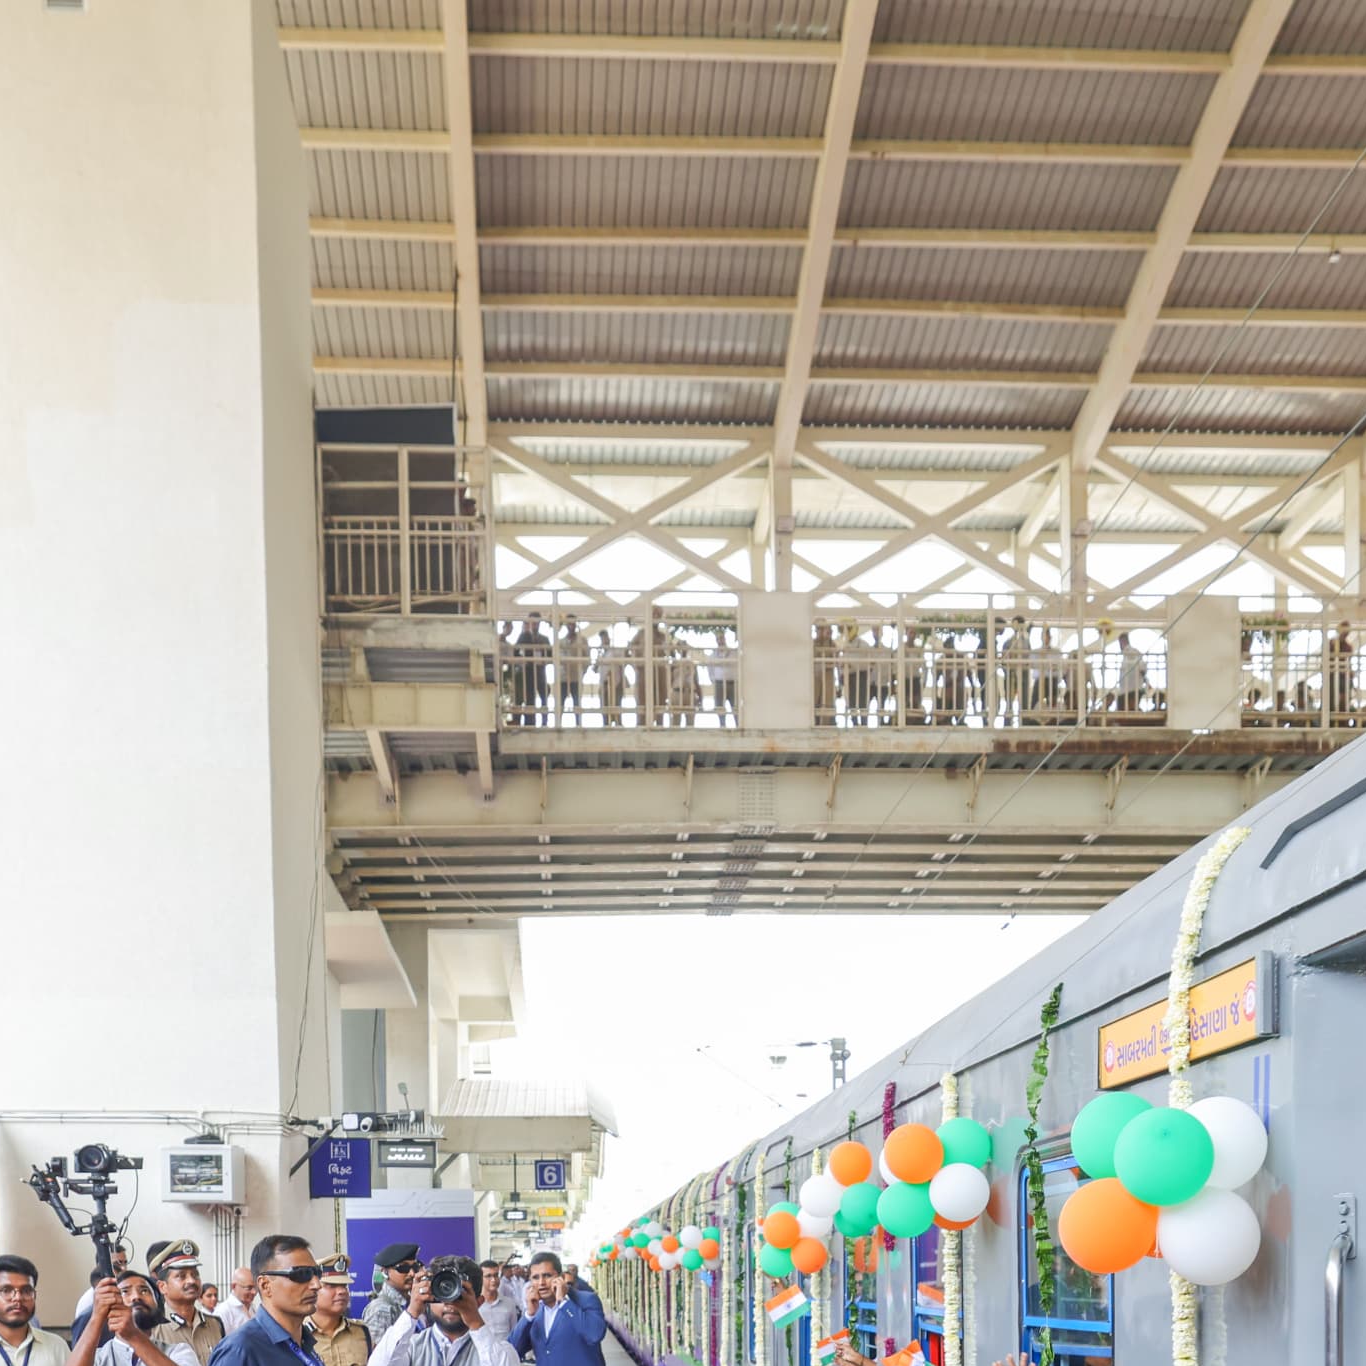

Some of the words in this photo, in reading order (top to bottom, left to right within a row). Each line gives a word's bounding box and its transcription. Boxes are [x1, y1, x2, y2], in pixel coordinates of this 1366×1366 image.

[1117, 1024, 1157, 1068] સાબરમતી
[1191, 1005, 1227, 1041] હેસાણા
[543, 1165, 557, 1184] 6
